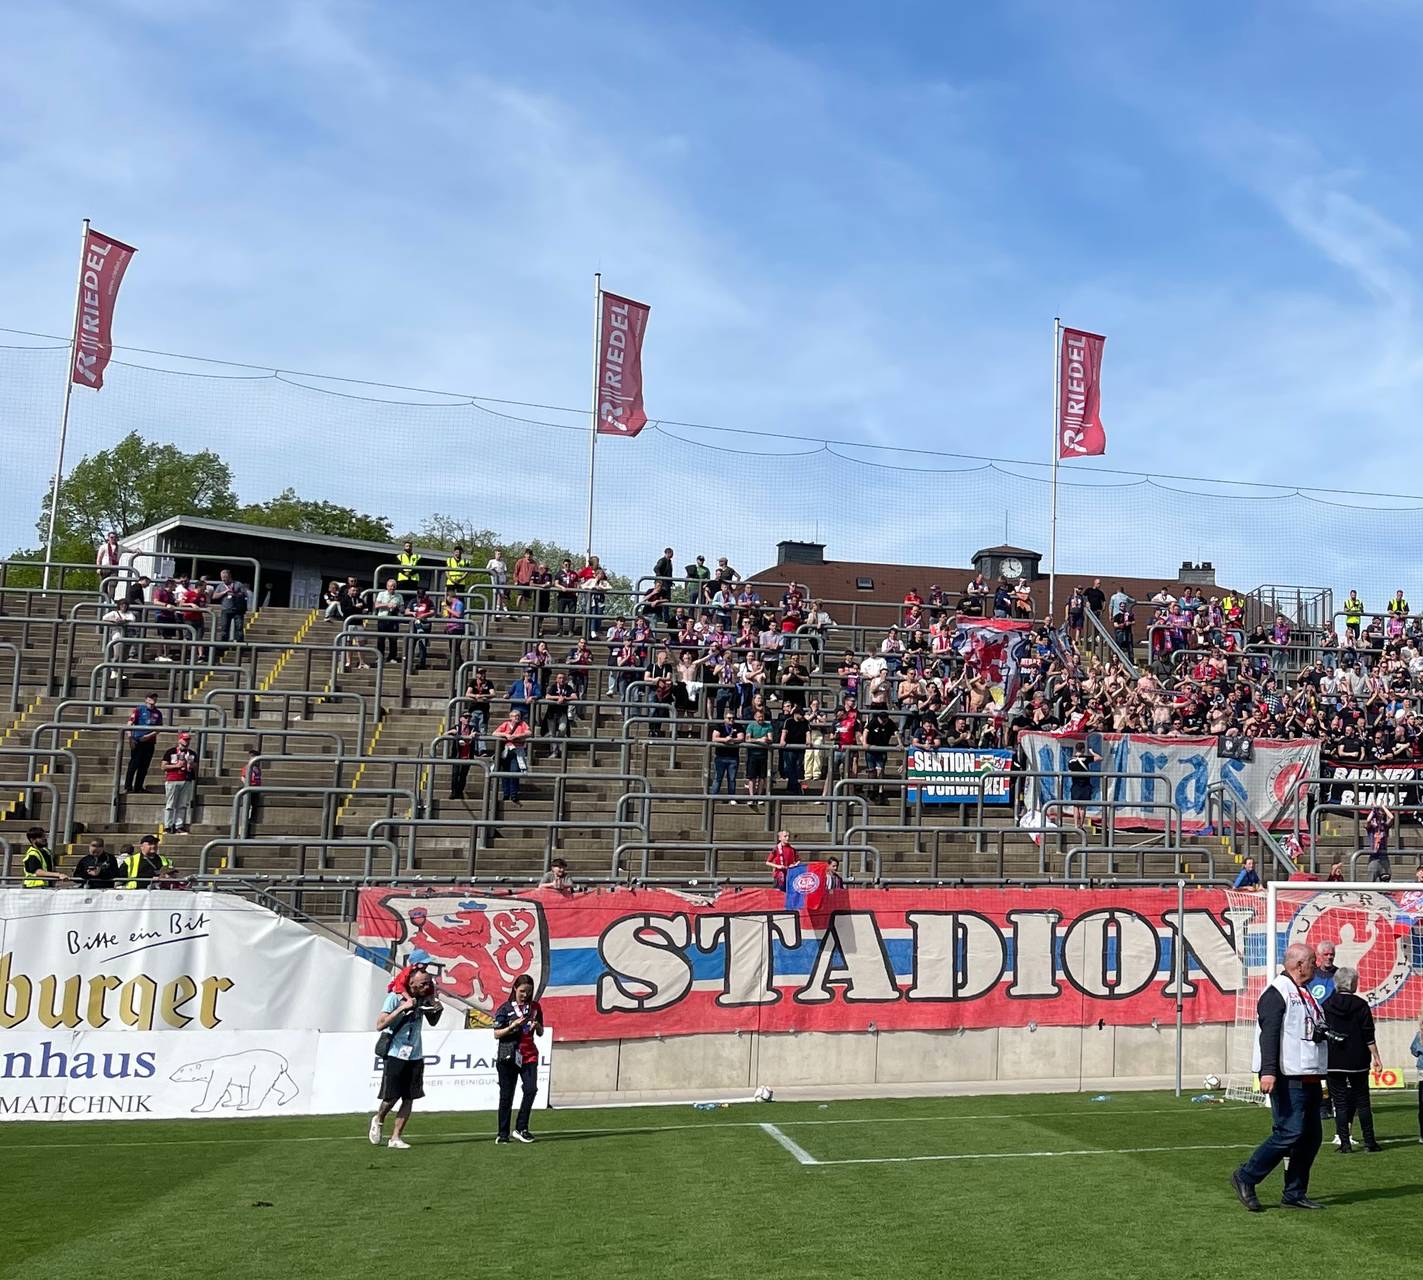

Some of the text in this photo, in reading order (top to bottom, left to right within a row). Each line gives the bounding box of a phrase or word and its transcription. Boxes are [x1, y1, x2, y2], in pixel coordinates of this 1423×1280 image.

[914, 751, 976, 773] SEKTION
[67, 912, 210, 954] Bitte ein Bit
[597, 908, 1255, 1014] STADION
[0, 951, 235, 1031] burger
[0, 1041, 157, 1079] nhaus
